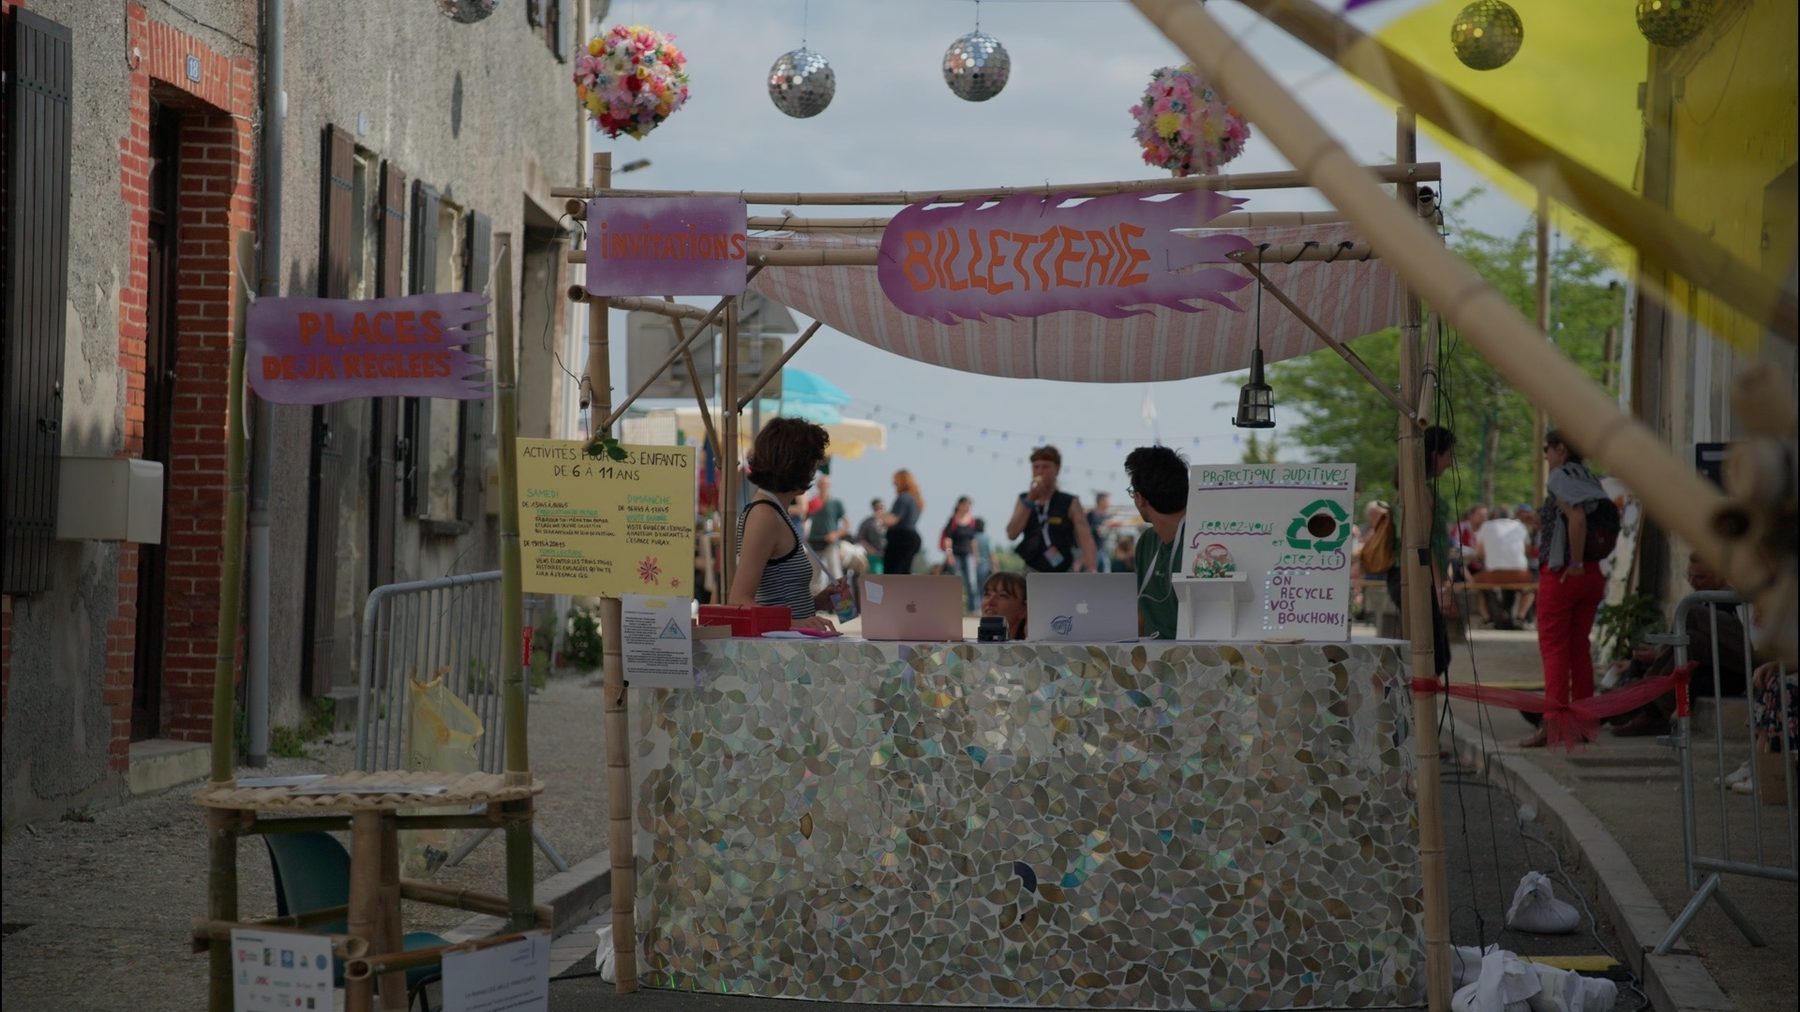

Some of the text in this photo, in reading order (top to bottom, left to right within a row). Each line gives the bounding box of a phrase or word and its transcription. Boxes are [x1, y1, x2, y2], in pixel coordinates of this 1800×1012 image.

[903, 223, 1150, 295] BILLETTERIE
[298, 310, 443, 346] PLACES
[523, 444, 576, 460] ACTIVITÉS
[640, 452, 688, 467] ENFANTS
[554, 465, 567, 477] DE
[572, 464, 580, 477] 6
[599, 467, 613, 479] 11
[616, 469, 640, 481] ANS
[1272, 576, 1292, 586] ON
[1281, 587, 1334, 600] RECYCLE
[1270, 600, 1296, 612] VOS
[1278, 612, 1345, 627] BOUCHONS!
